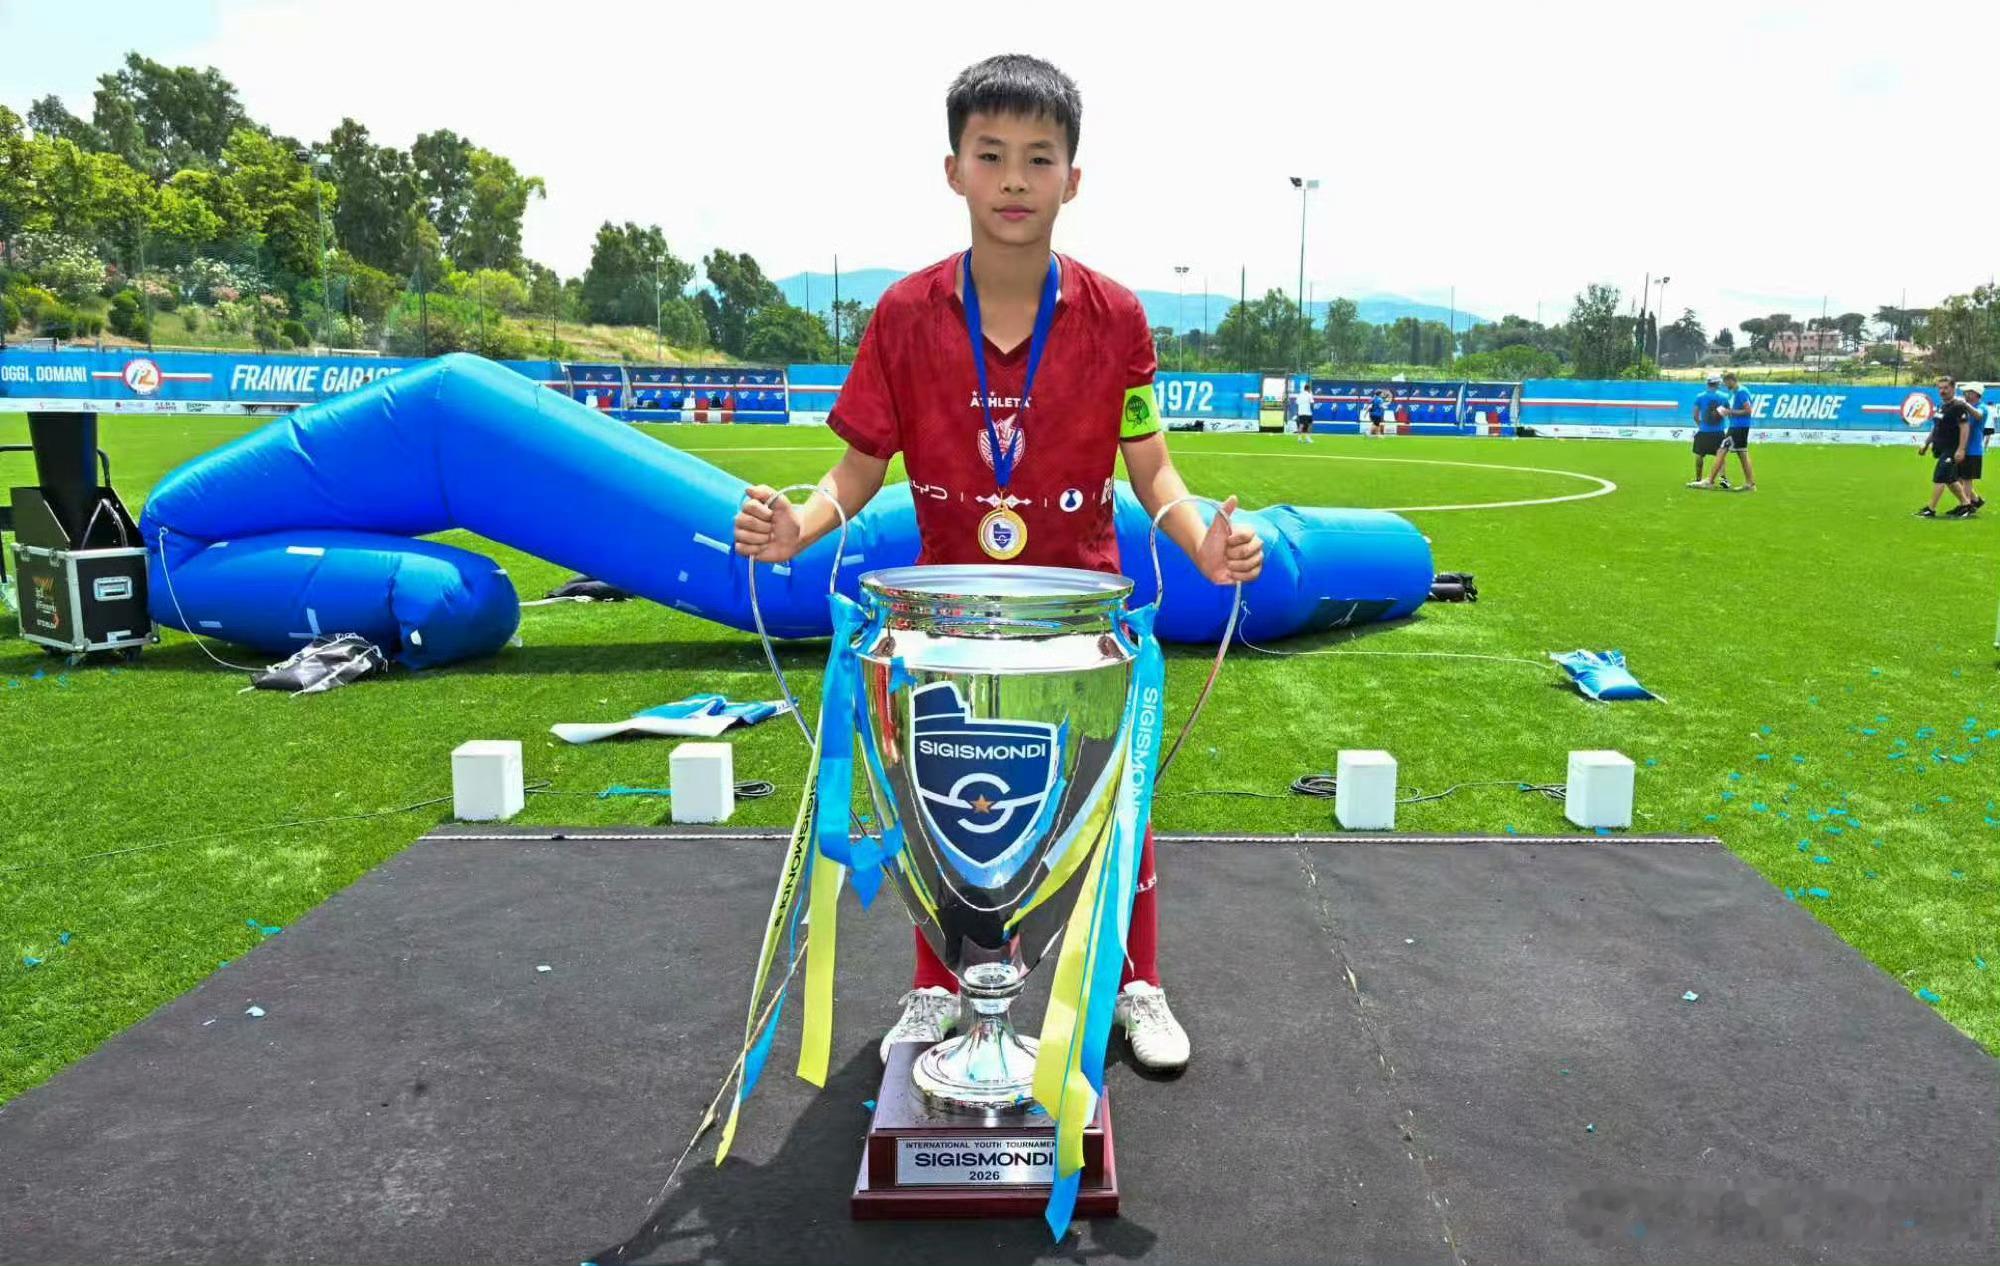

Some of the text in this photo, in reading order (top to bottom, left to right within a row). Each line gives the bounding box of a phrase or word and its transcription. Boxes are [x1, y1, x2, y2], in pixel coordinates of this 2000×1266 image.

[1, 365, 87, 384] OGGI, DOMANI
[230, 364, 320, 392] FRANKIE
[1155, 380, 1214, 411] 1972
[1773, 394, 1847, 419] GARAGE
[920, 740, 1046, 760] SIGISMONDI
[906, 1141, 970, 1149] INTERNATIONAL
[974, 1141, 1002, 1149] YOUTH
[915, 1152, 1054, 1167] SIGISMONDI
[969, 1171, 1000, 1181] 2026
